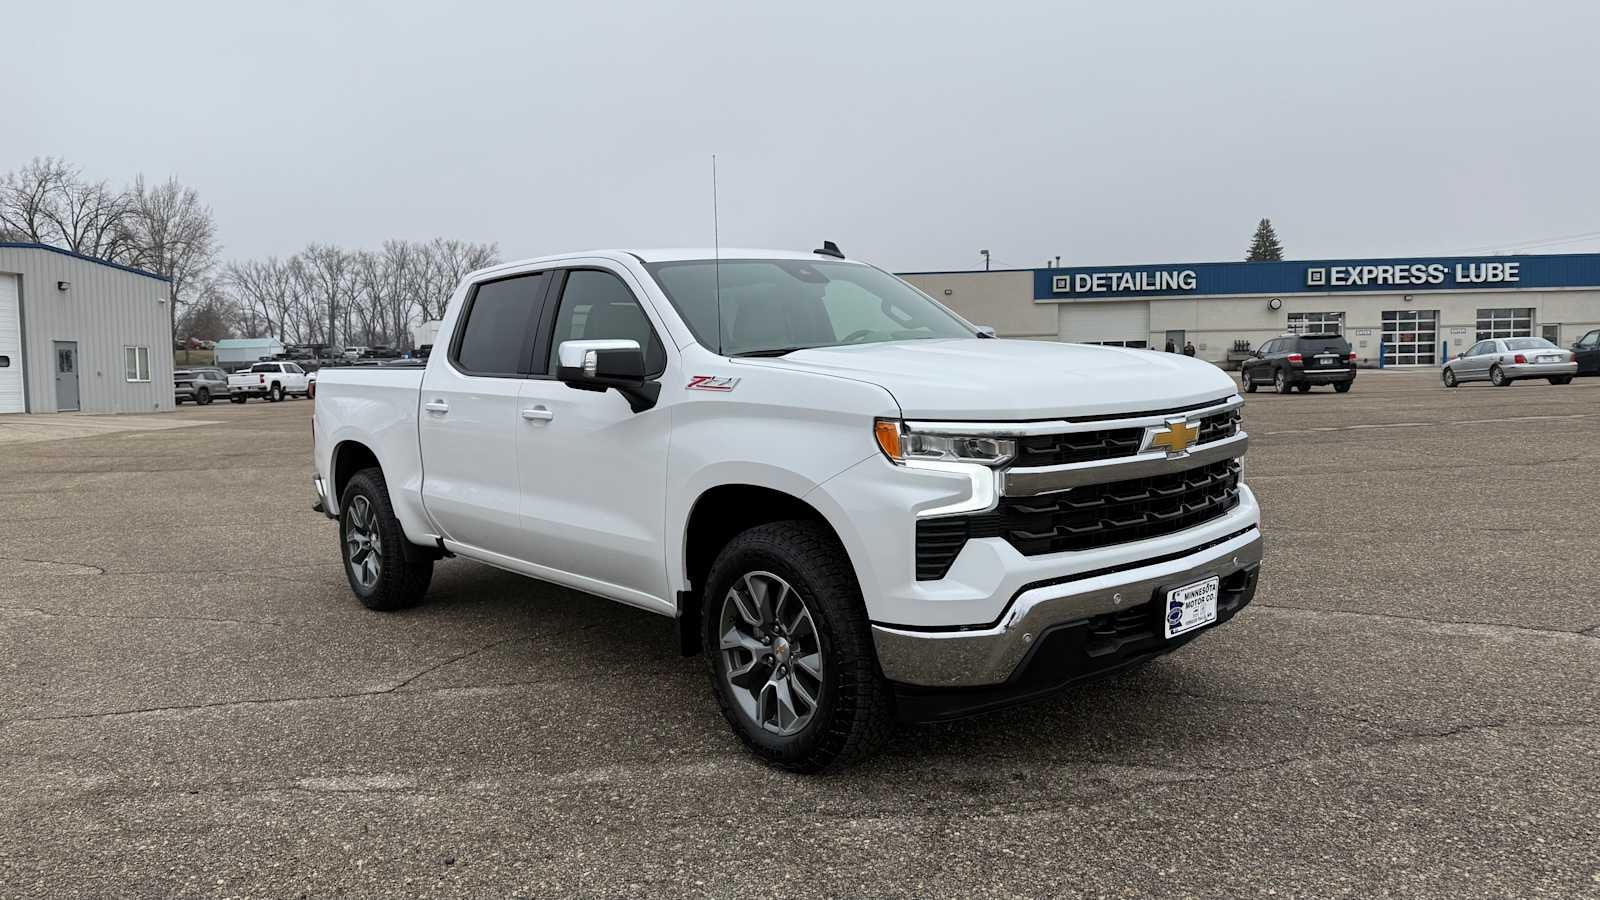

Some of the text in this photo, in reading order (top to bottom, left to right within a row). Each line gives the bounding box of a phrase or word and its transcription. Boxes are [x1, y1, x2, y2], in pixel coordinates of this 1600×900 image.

[1074, 269, 1197, 293] DETAILING
[1330, 262, 1520, 286] EXPRESS LUBE
[686, 375, 742, 392] Z71
[1184, 583, 1216, 601] MINNESOTA
[1185, 596, 1205, 609] MOTOR
